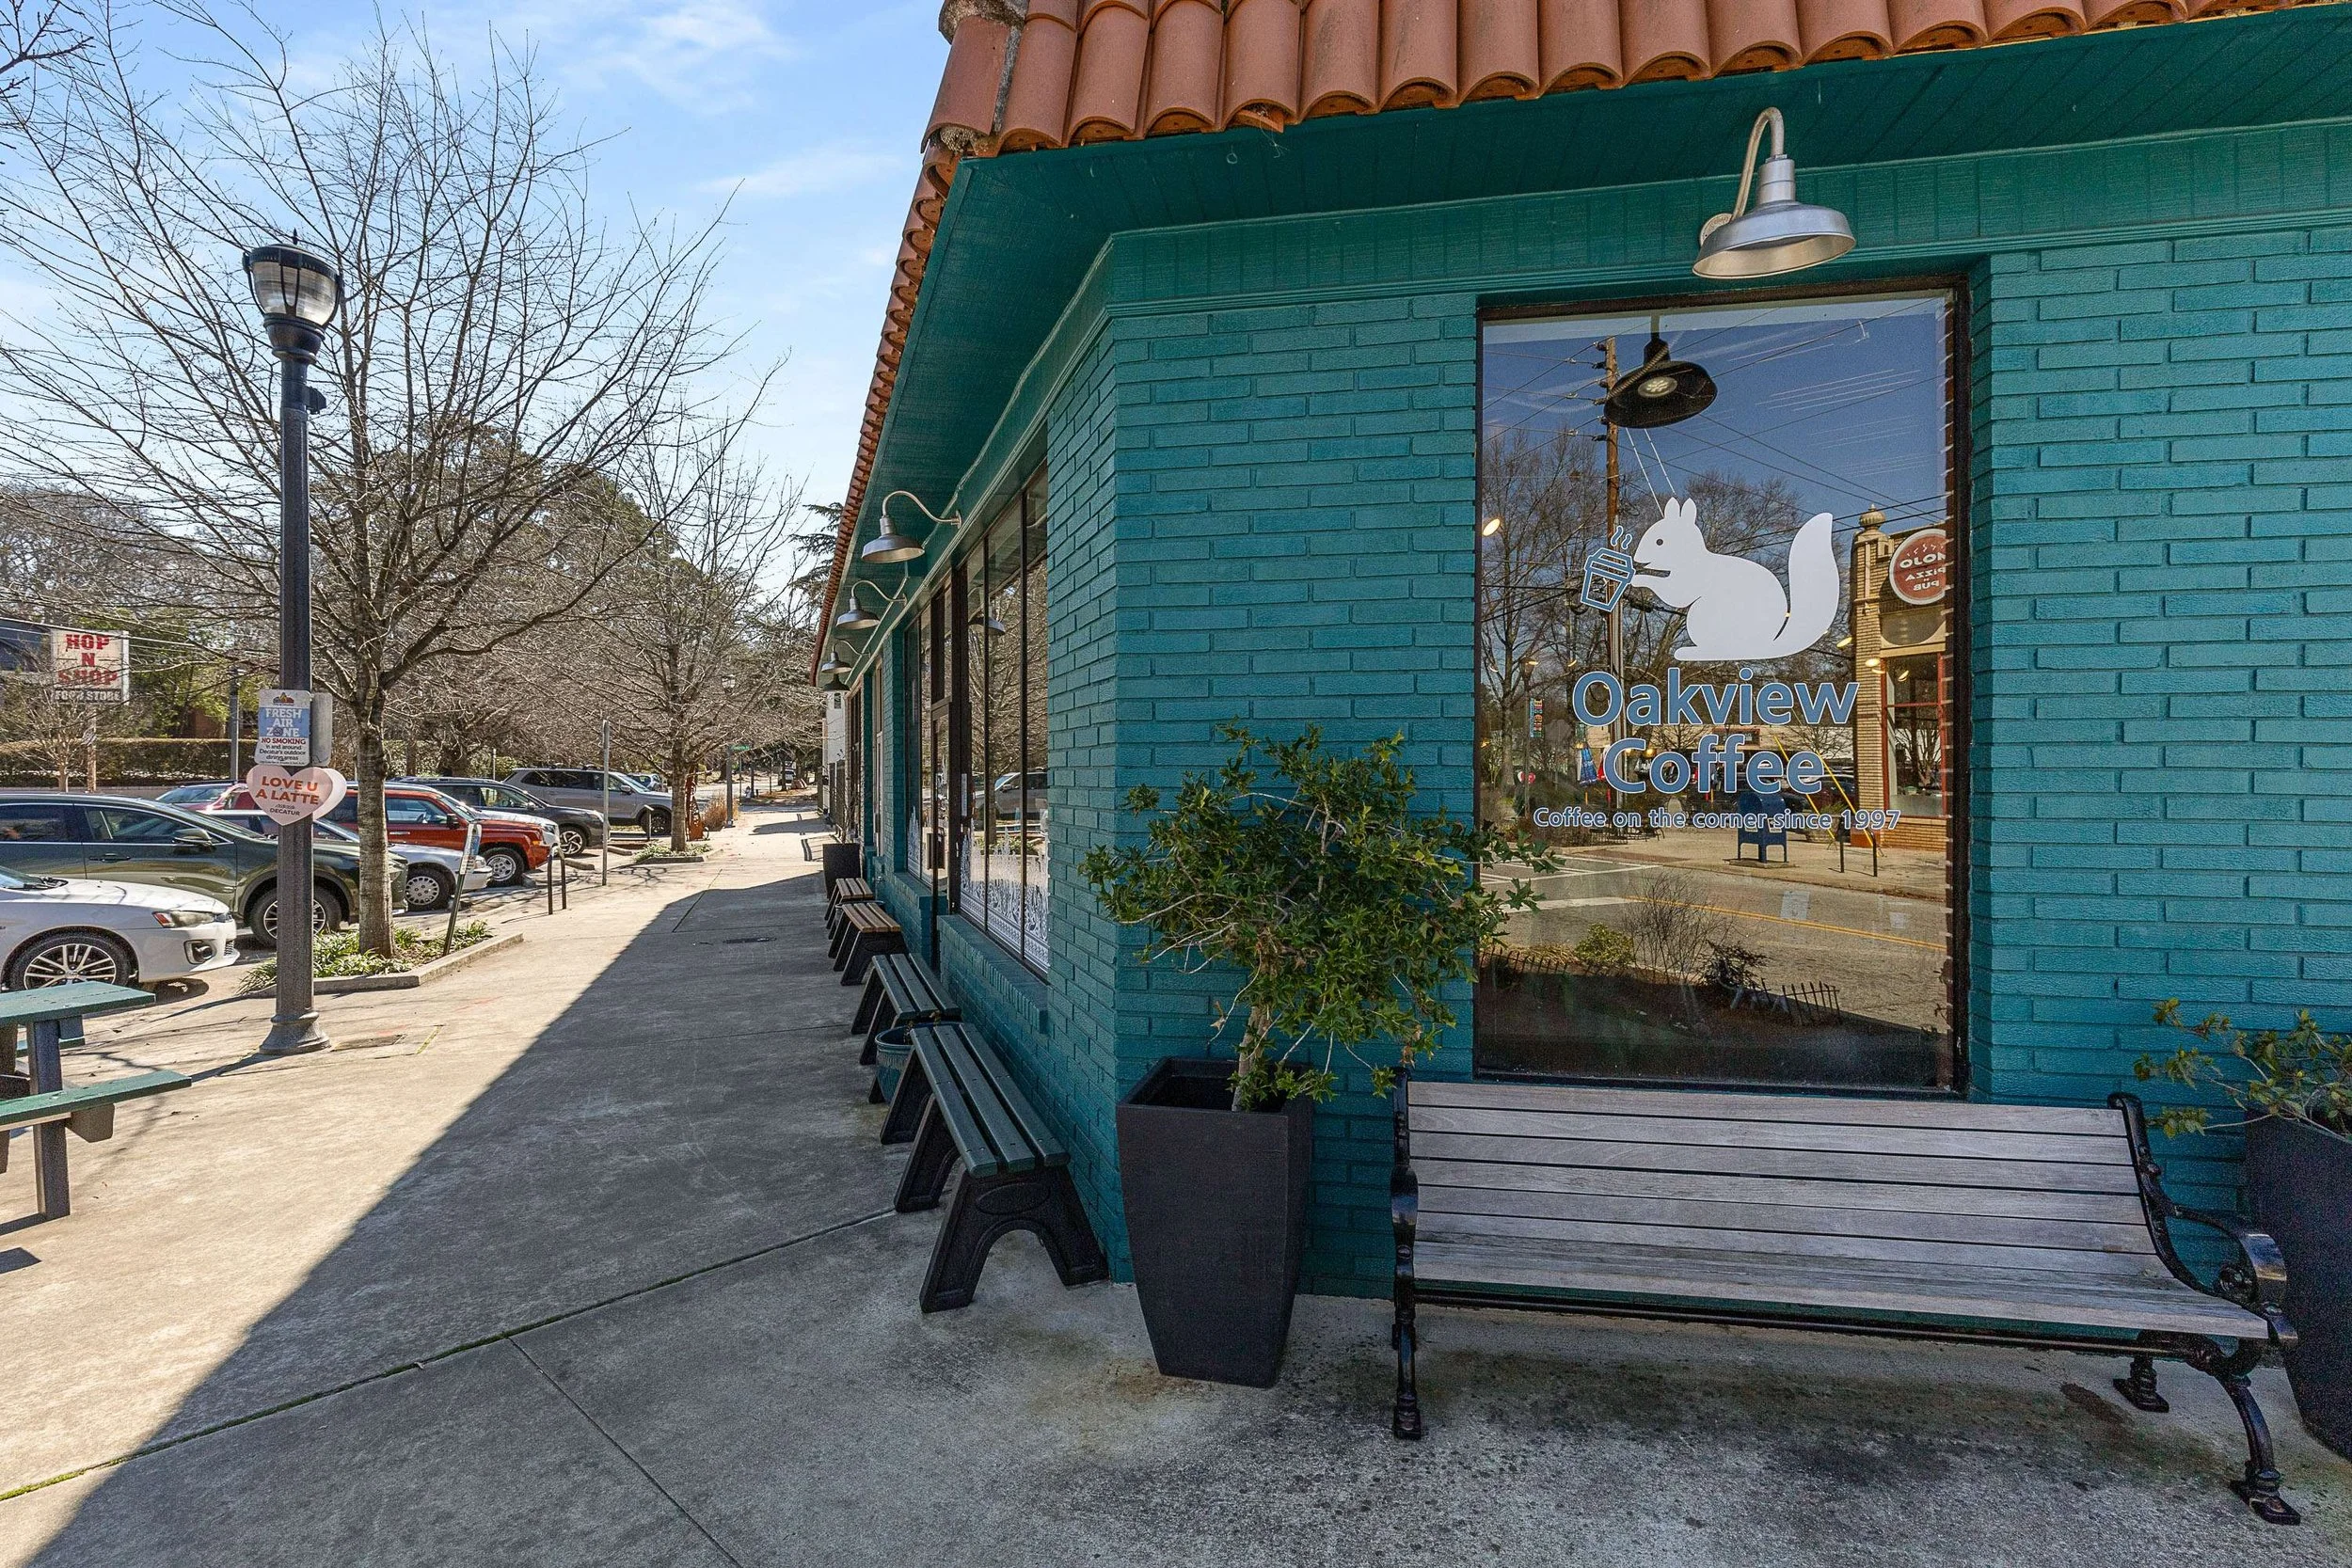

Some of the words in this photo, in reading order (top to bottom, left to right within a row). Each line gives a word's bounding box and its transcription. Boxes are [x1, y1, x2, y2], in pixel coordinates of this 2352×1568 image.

[66, 634, 110, 649] HOP
[82, 653, 95, 667] N
[57, 669, 118, 685] SHOP
[1572, 667, 1860, 726] Oakview
[265, 708, 302, 719] FRESH
[273, 719, 294, 728] AIR
[266, 728, 300, 737] ZONE
[1602, 734, 1825, 794] Coffee
[262, 776, 303, 790] LOVE
[307, 782, 318, 791] U
[255, 788, 267, 800] A
[271, 790, 319, 805] LATTE
[269, 808, 300, 816] DECATUR
[1533, 806, 1607, 828] Coffee
[1612, 812, 1642, 828] on
[1648, 807, 1686, 829] the
[1692, 812, 1768, 830] corner
[1774, 808, 1832, 831] since
[1841, 809, 1901, 831] 1997
